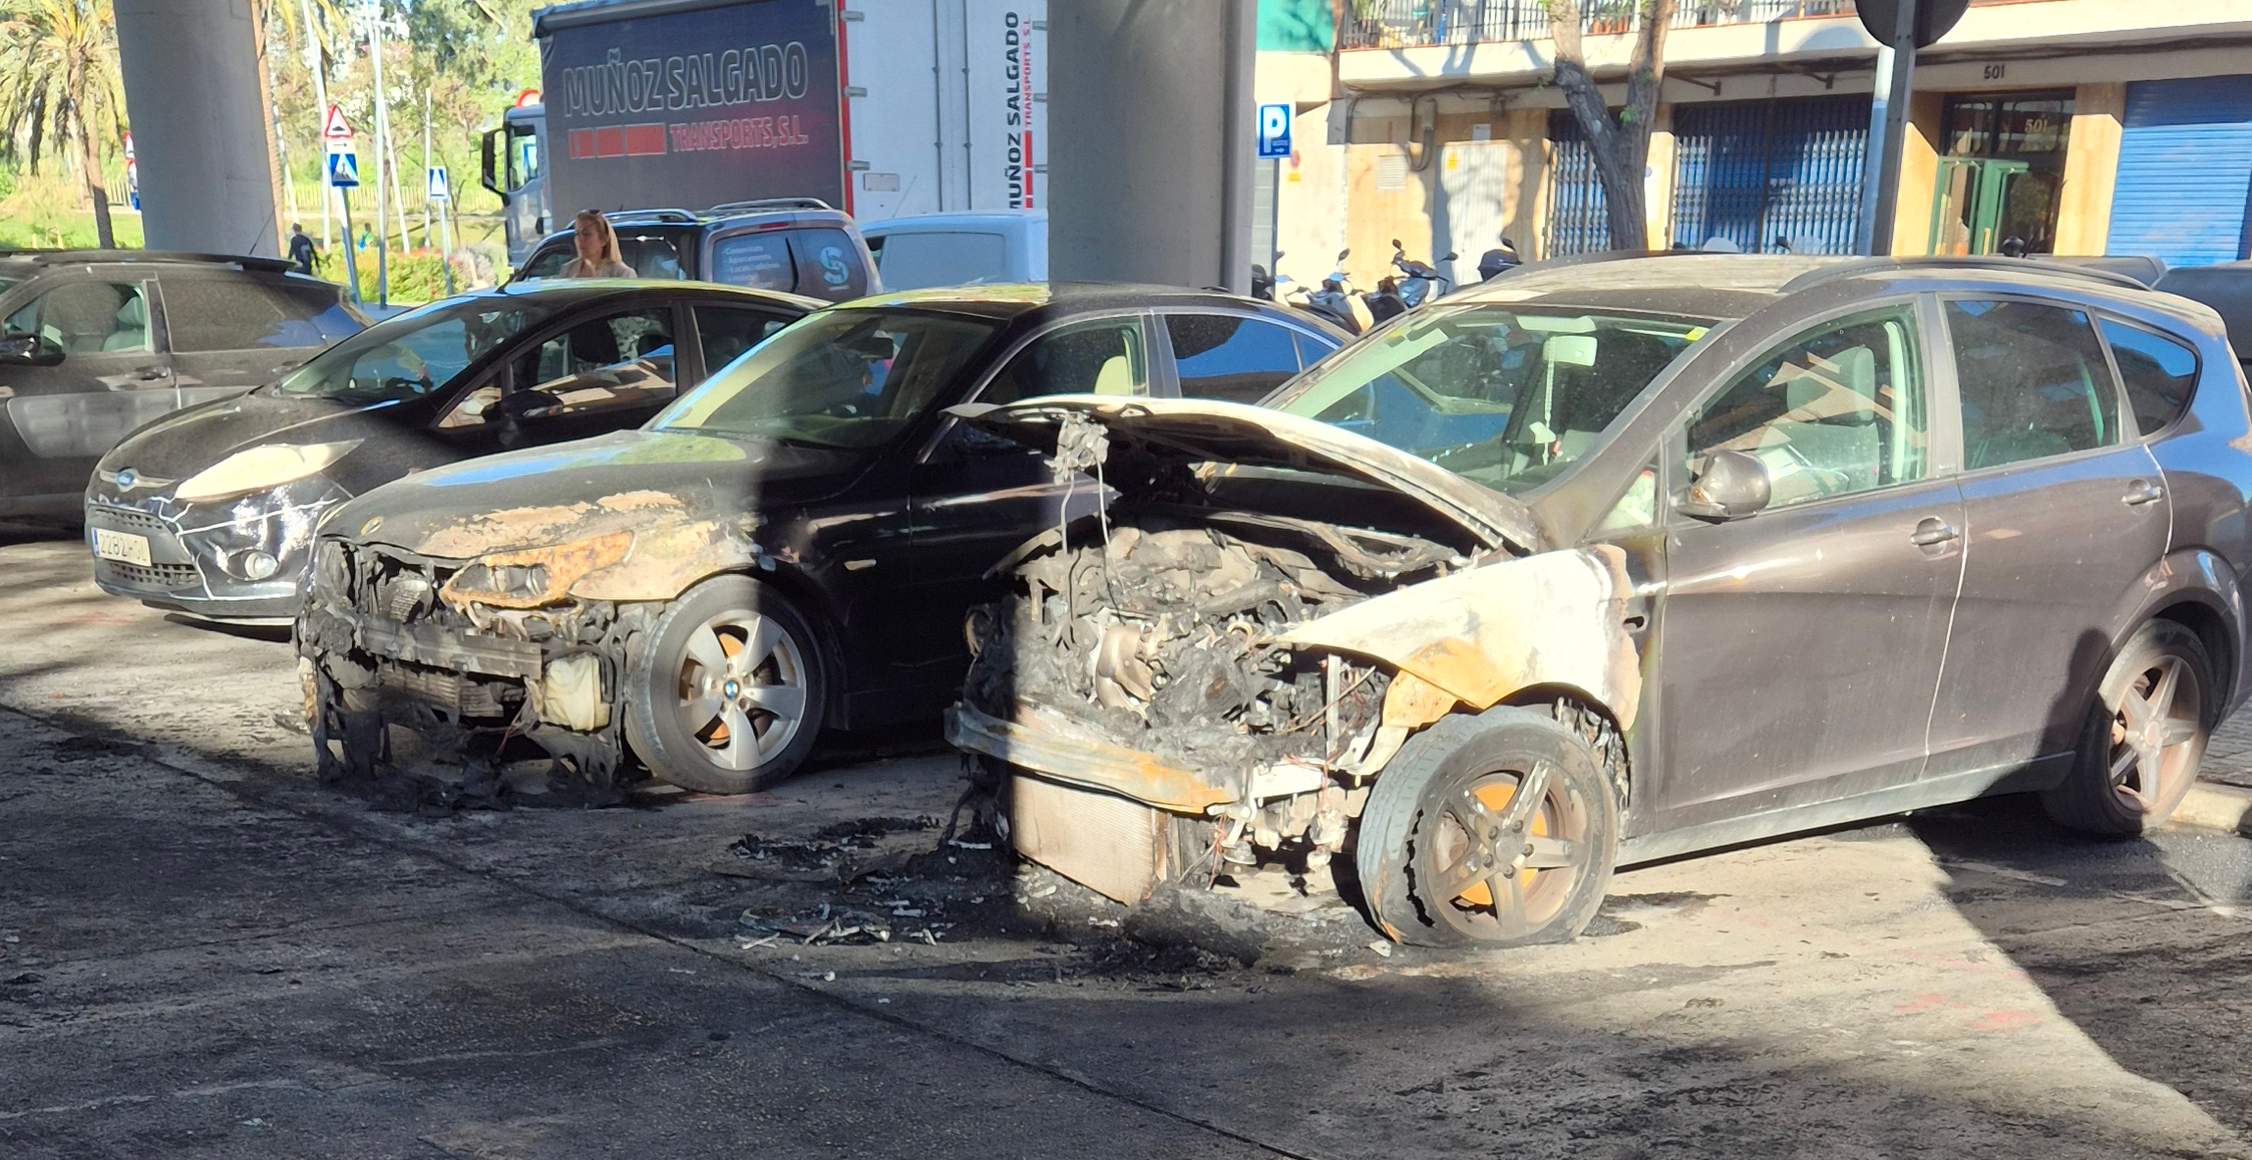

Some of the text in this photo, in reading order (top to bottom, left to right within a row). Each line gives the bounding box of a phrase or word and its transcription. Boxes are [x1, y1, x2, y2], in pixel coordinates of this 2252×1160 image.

[564, 41, 809, 118] MUÑOZ SALGADO
[1005, 11, 1021, 127] SALGADO
[1984, 63, 2006, 80] 501
[1263, 106, 1287, 153] P
[2024, 119, 2048, 134] 501
